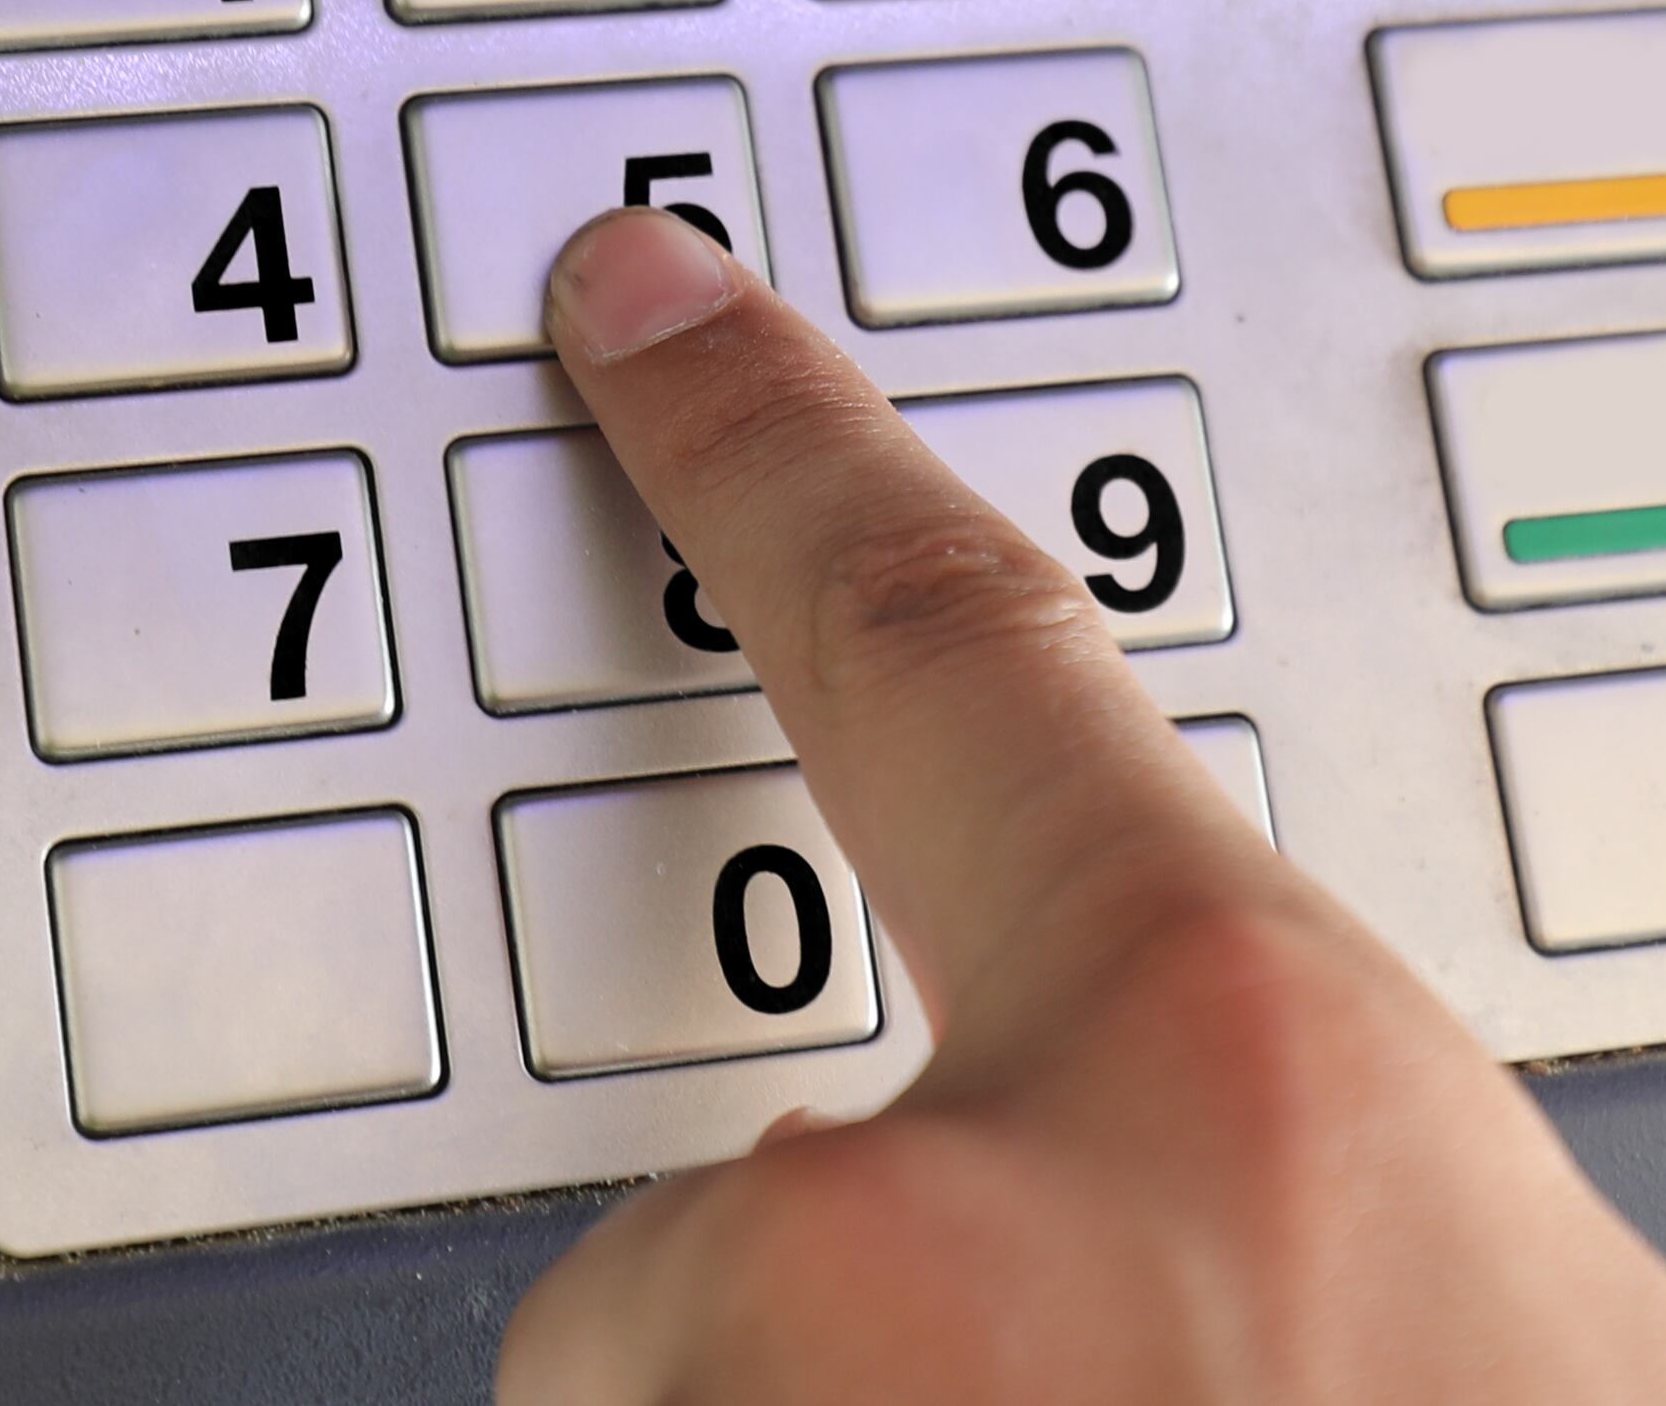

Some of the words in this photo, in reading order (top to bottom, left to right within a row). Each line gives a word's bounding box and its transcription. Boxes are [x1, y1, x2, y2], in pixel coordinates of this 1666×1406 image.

[190, 185, 316, 344] 4
[1021, 119, 1134, 271] 6
[1069, 452, 1185, 614] 9
[228, 530, 344, 702] 7
[711, 843, 833, 1016] 0
